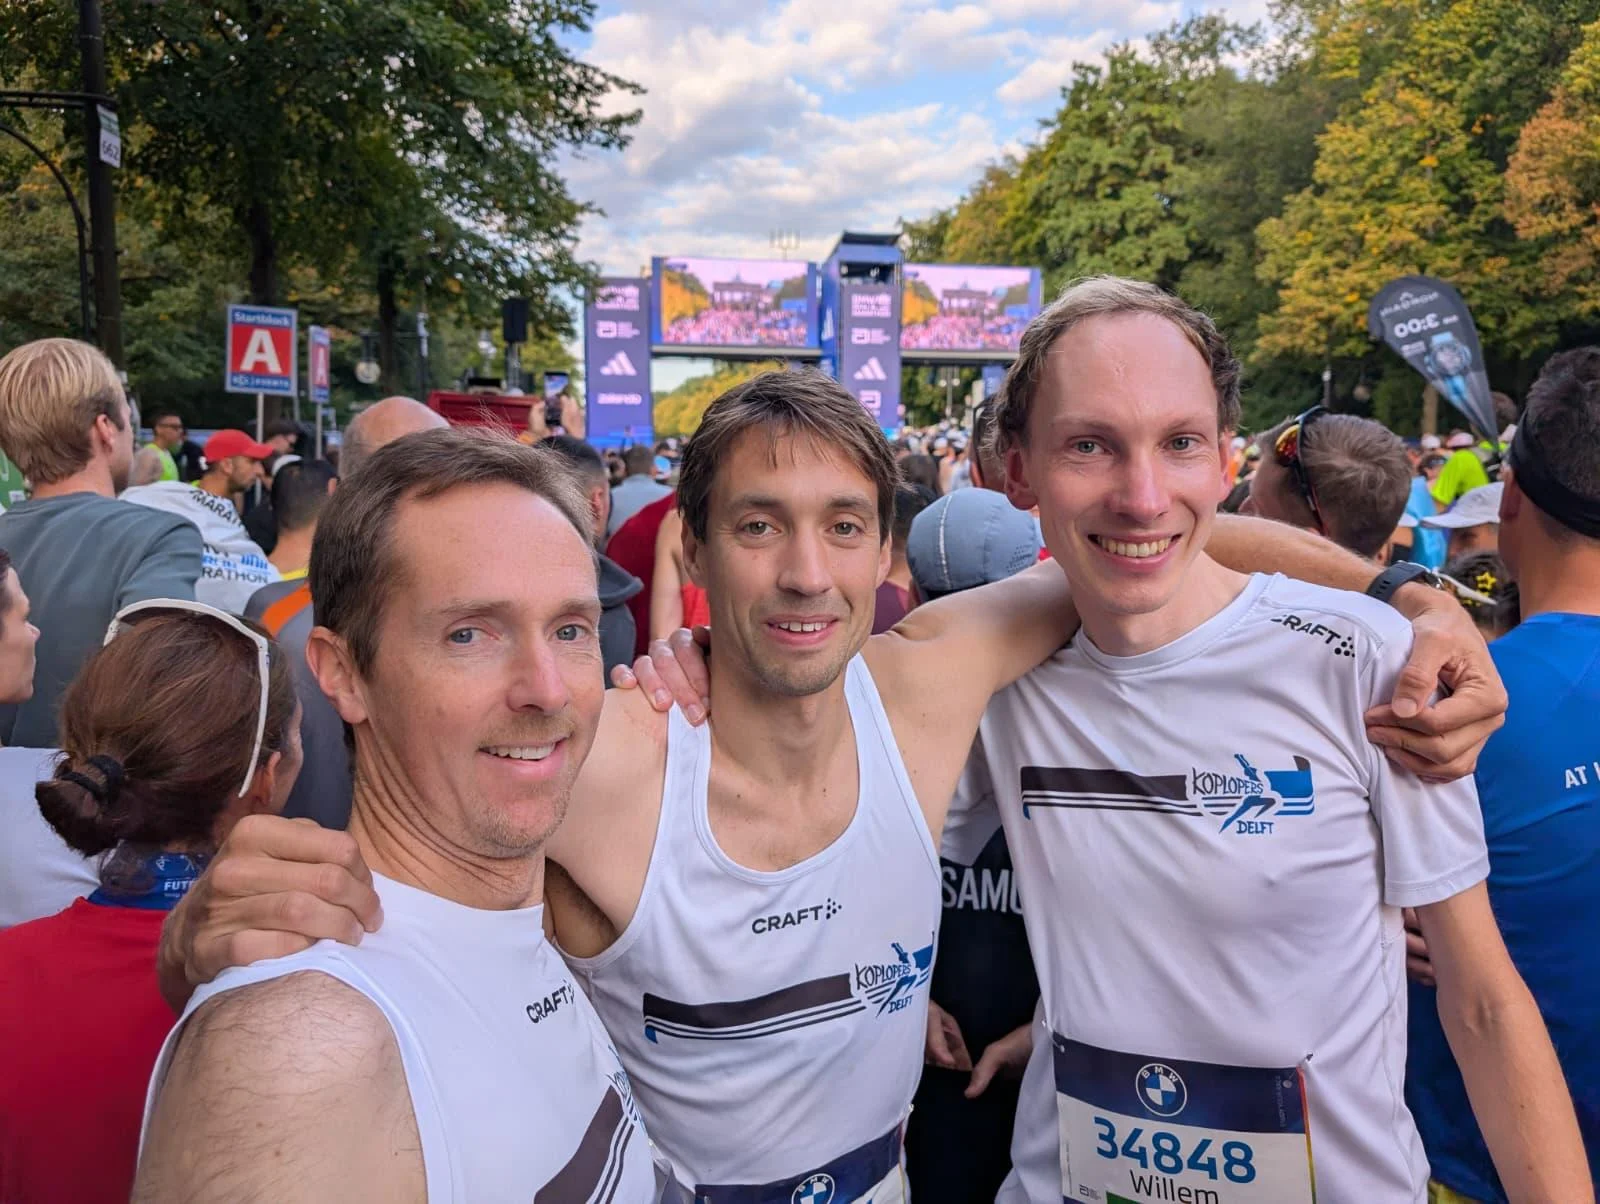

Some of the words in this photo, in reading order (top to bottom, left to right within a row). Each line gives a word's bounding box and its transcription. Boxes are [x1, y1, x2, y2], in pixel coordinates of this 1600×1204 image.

[240, 328, 282, 374] A
[1192, 766, 1264, 796] KOPLOPERS
[1565, 765, 1588, 789] AT
[1236, 820, 1275, 834] DELFT
[752, 904, 824, 935] CRAFT
[855, 962, 912, 991] KOPLOPERS
[526, 985, 568, 1024] CRAFT
[888, 994, 913, 1014] DELFT
[1094, 1116, 1256, 1184] 34848
[1129, 1169, 1219, 1204] Willem
